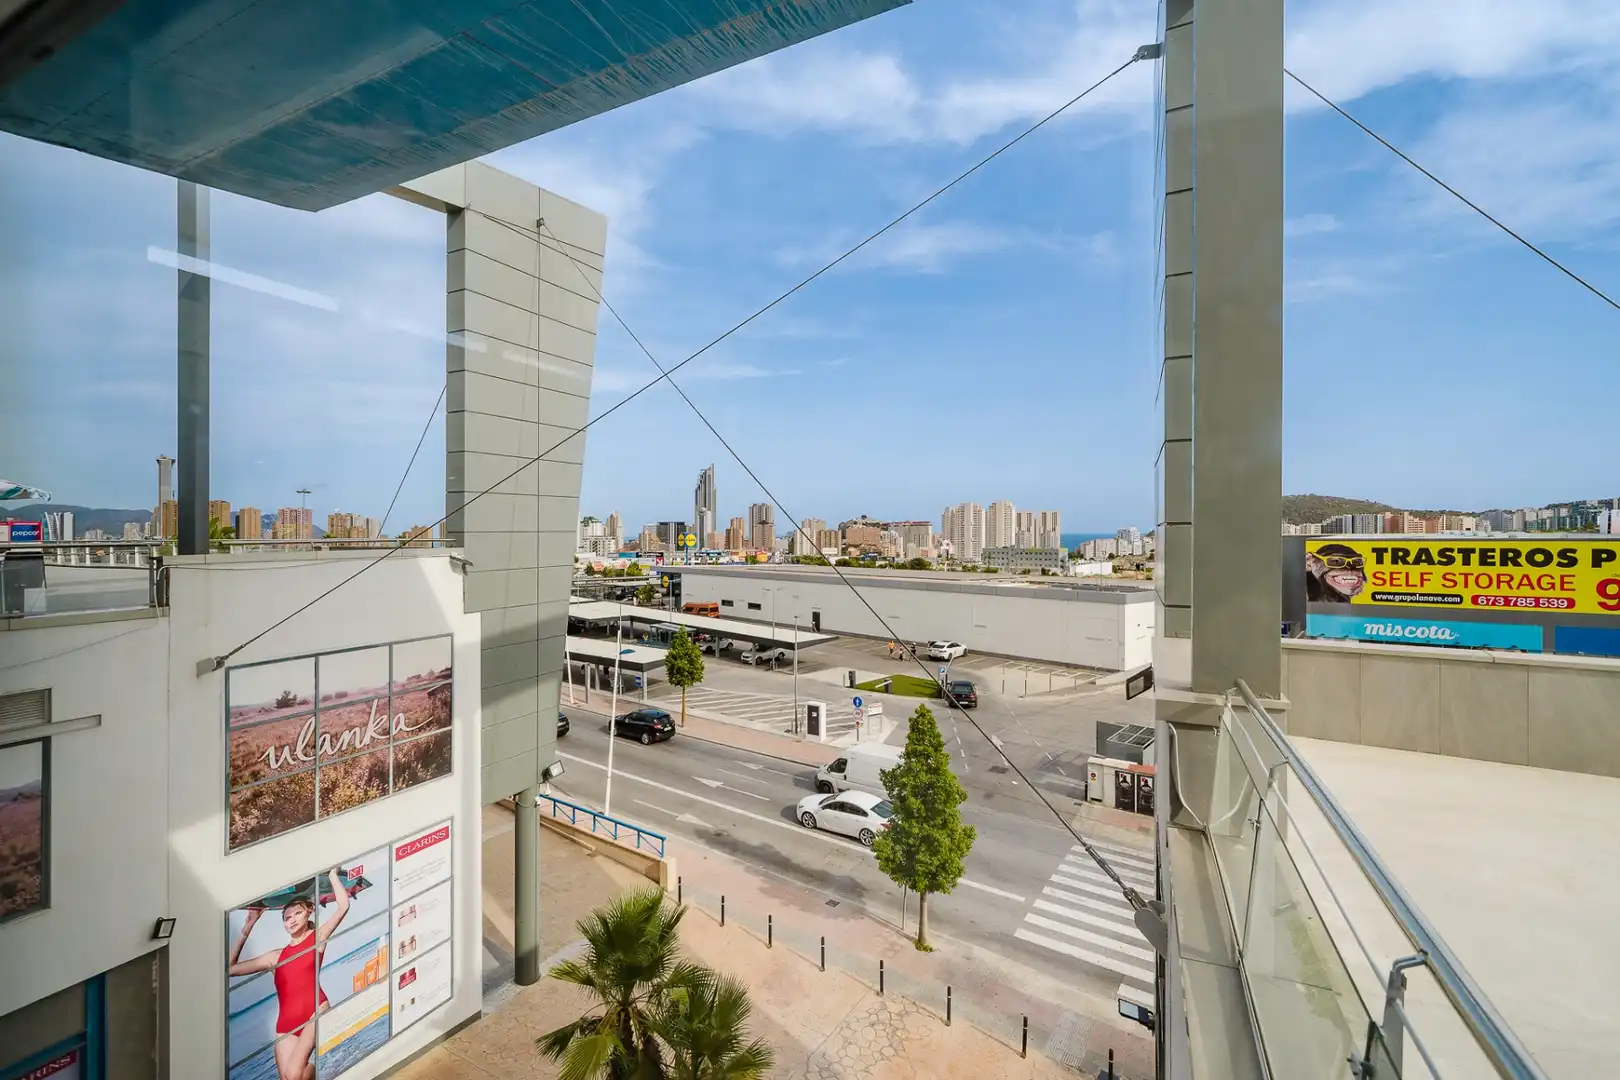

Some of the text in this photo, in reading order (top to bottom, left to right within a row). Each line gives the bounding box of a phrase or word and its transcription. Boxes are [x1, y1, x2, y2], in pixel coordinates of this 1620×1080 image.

[1371, 547, 1617, 569] TRASTEROS P
[1371, 571, 1576, 592] SELF STORAGE
[1374, 593, 1461, 604] www.grupolanave.com
[1478, 596, 1568, 608] 673 785 539
[1364, 623, 1456, 640] miscota
[258, 698, 434, 769] ulanka
[398, 830, 447, 856] CLARINS
